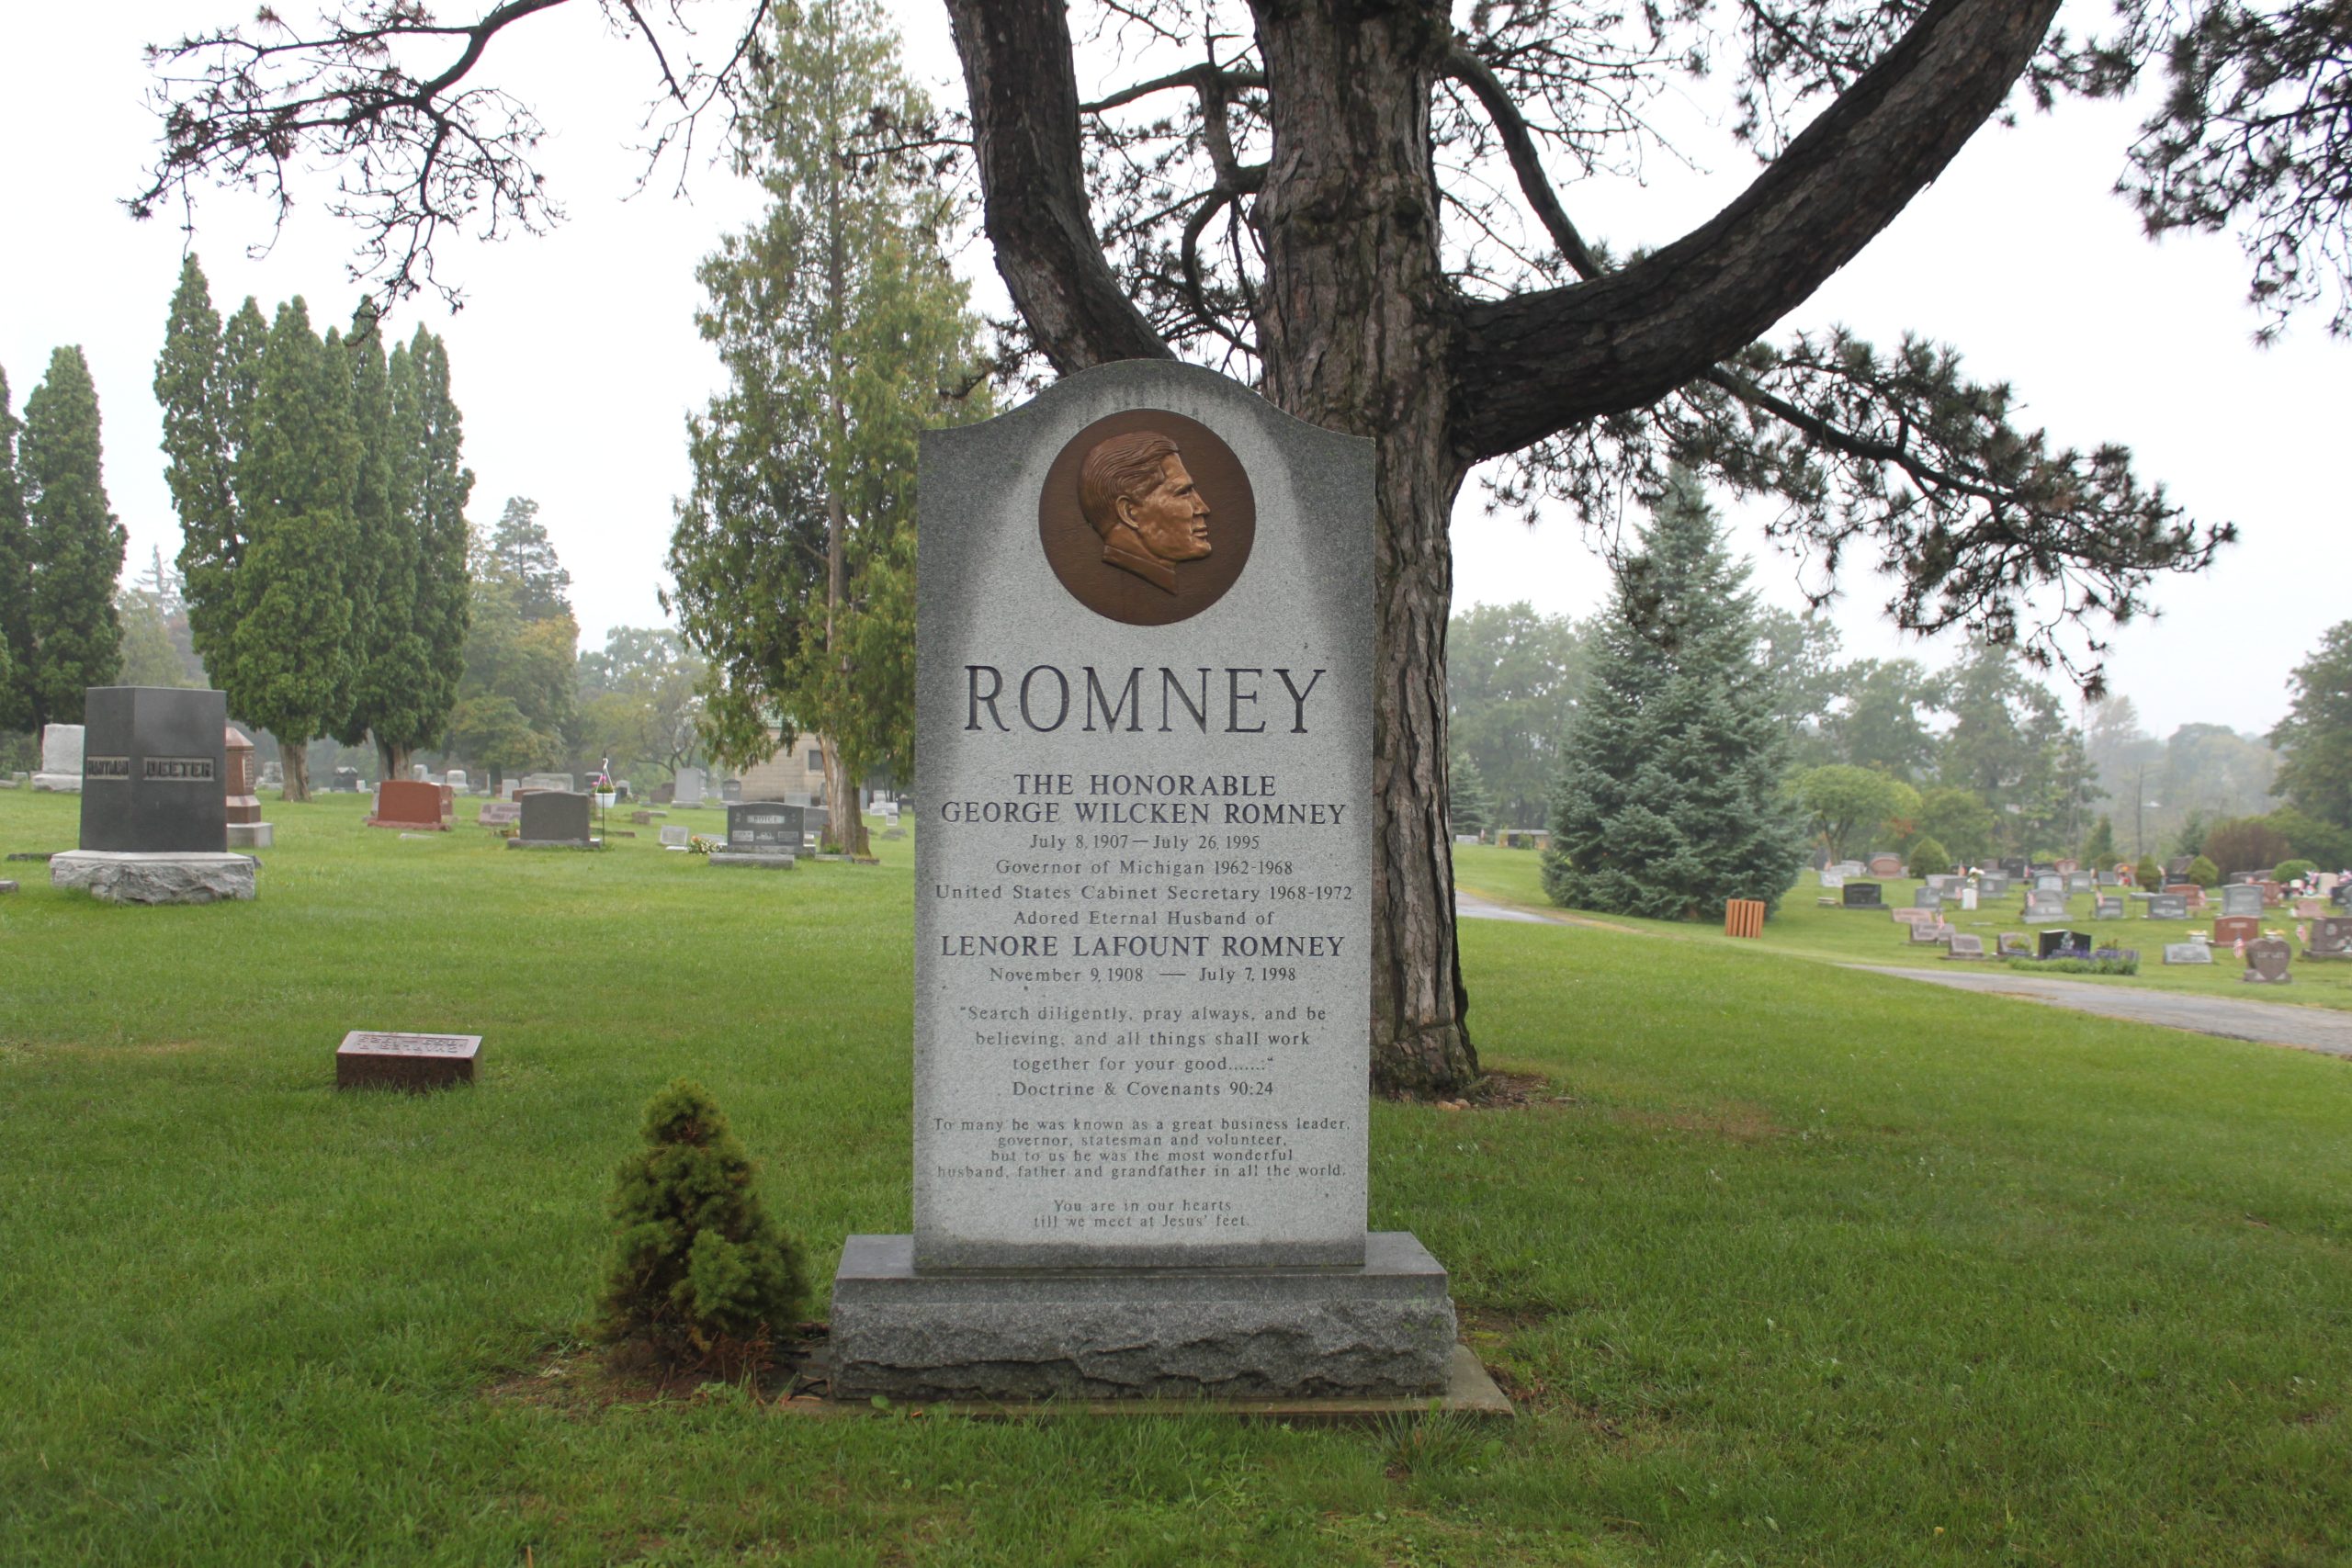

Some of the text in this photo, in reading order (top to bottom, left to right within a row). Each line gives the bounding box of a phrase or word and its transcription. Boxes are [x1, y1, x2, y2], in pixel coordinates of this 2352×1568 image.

[965, 664, 1327, 735] ROMNEY
[1013, 773, 1276, 796] THE HONORABLE
[942, 801, 1346, 825] GEORGE WILCKEN ROMNEY
[1030, 834, 1066, 852] July
[1076, 834, 1089, 851] 8,
[1094, 834, 1128, 849] 1907
[1153, 835, 1188, 852] July
[1198, 835, 1220, 851] 26,
[1227, 835, 1259, 850] 1995
[996, 859, 1293, 877] Governor of Michigan 1962-1968
[935, 885, 1351, 903] United States Cabinet Secretary 1968-1972
[1013, 910, 1274, 925] Adored Eternal Husband of
[942, 935, 1345, 957] LENORE LAFOUNT ROMNEY
[989, 967, 1081, 982] November
[1091, 967, 1101, 983] 9,
[1108, 967, 1143, 982] 1908
[1199, 967, 1236, 984] July
[1245, 967, 1255, 982] 7,
[1262, 967, 1296, 981] 1998
[1038, 1007, 1132, 1023] diligently,
[1144, 1010, 1182, 1023] pray
[1192, 1007, 1255, 1023] always,
[1265, 1007, 1296, 1020] and
[1306, 1006, 1326, 1021] be
[976, 1032, 1309, 1048] believing, and all things shall work
[1013, 1056, 1091, 1074] together
[1100, 1056, 1125, 1070] for
[1135, 1060, 1174, 1074] your
[1012, 1081, 1273, 1096] Doctrine & Covenants 90:24
[933, 1117, 1351, 1133] To many he was known as a great business leader,
[998, 1134, 1287, 1148] governor, statesman and volunteer,
[991, 1149, 1293, 1162] but to us he was the most wonderful
[937, 1164, 1347, 1179] husband, father and grandfather in all the world.
[1055, 1199, 1232, 1212] You are in our hearts
[1035, 1215, 1057, 1227] till
[1069, 1218, 1084, 1227] we
[1094, 1217, 1131, 1227] meet
[1140, 1217, 1153, 1226] at
[1216, 1214, 1250, 1227] feet.
